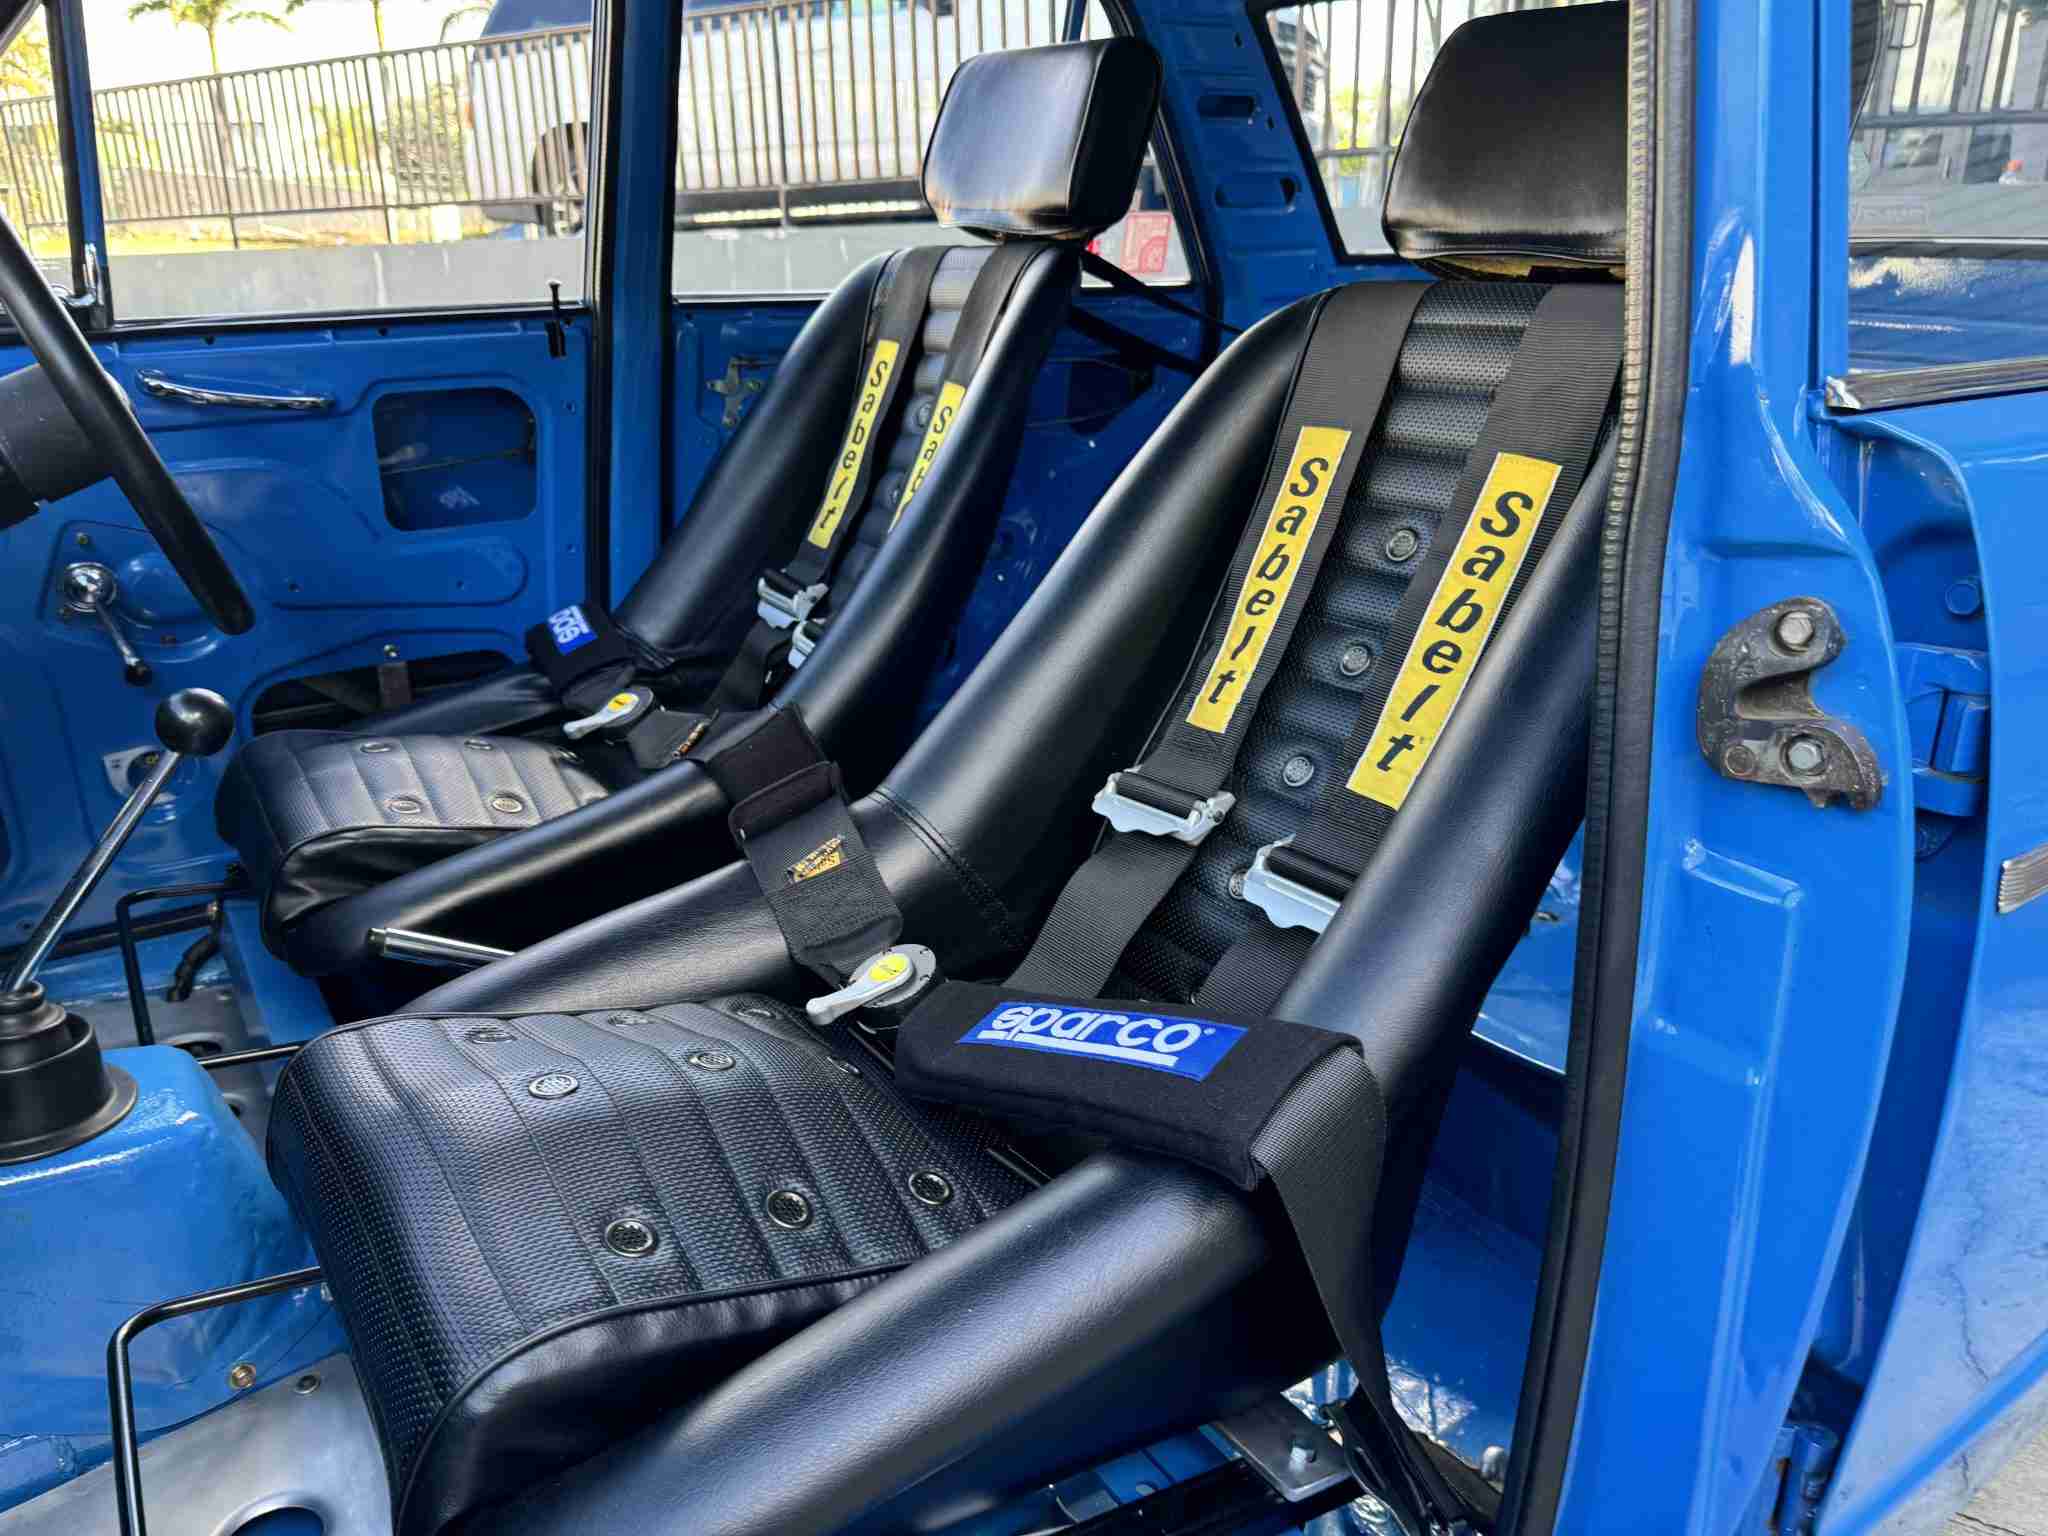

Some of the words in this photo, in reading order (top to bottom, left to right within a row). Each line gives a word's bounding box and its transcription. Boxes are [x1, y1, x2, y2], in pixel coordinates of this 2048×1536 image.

[820, 360, 888, 529] Sabelt
[1208, 457, 1329, 704] Sabelt
[1376, 491, 1534, 772] Sabelt
[991, 1006, 1201, 1053] sparco
